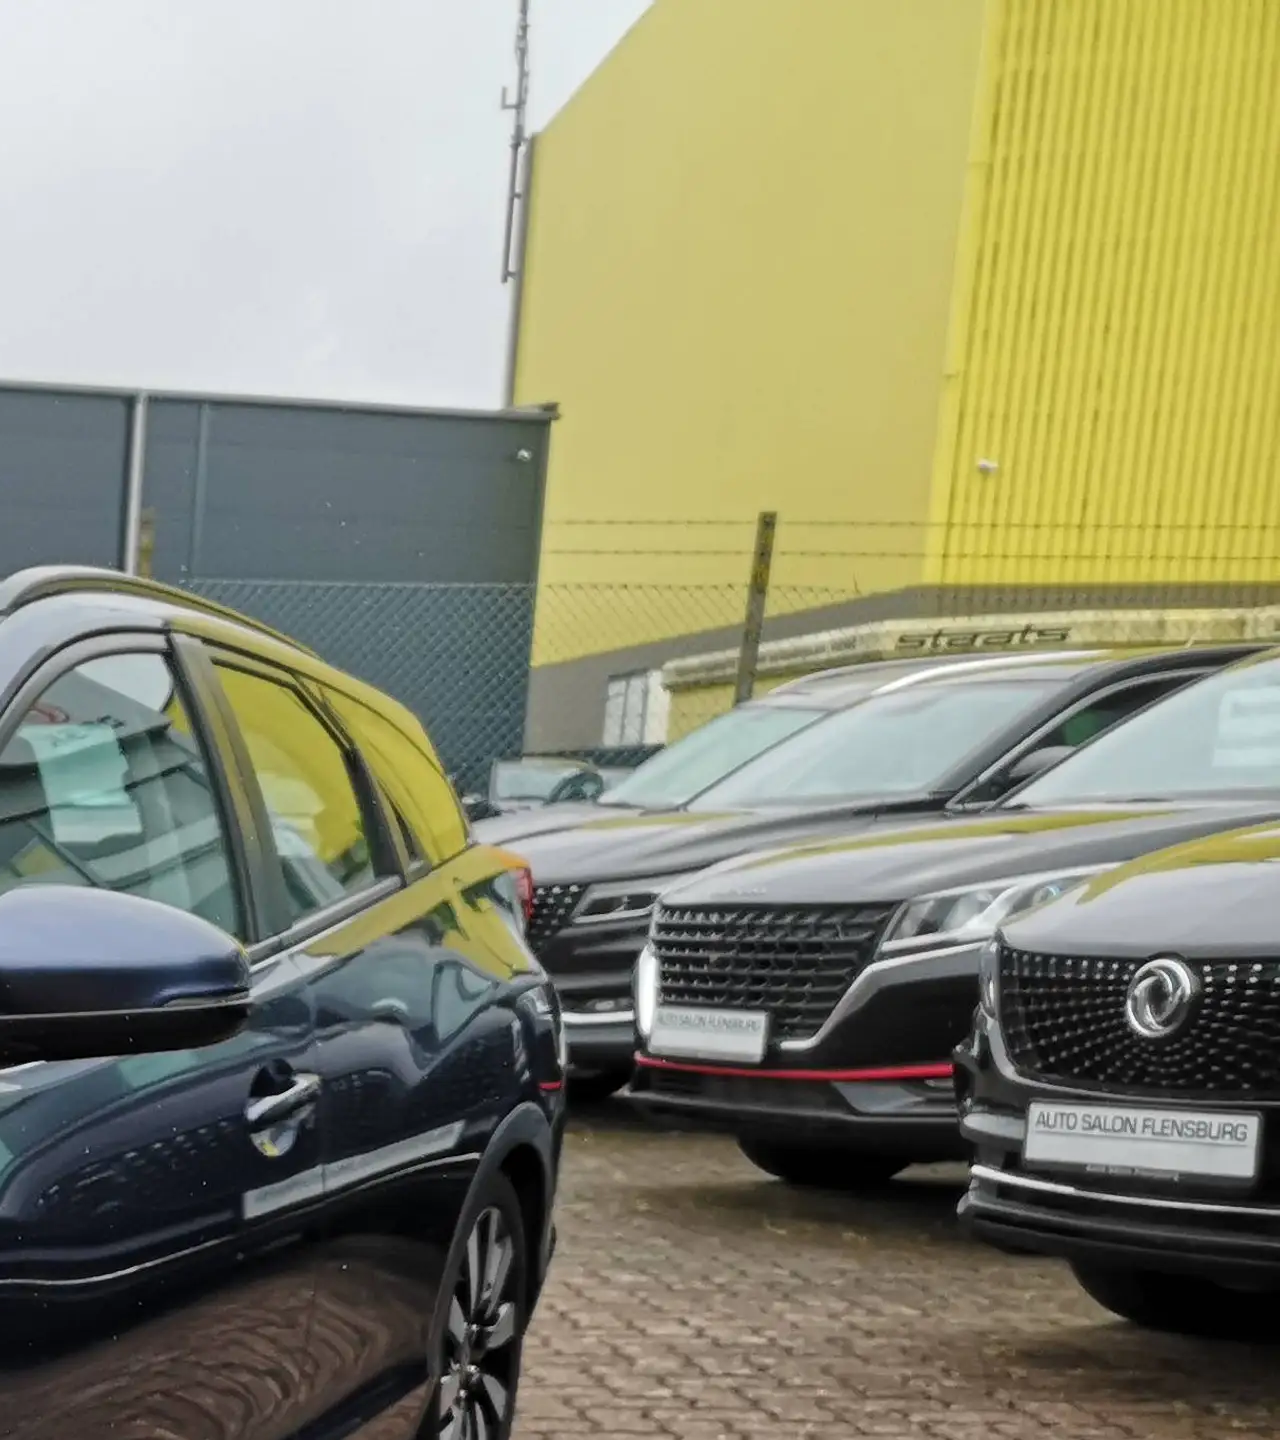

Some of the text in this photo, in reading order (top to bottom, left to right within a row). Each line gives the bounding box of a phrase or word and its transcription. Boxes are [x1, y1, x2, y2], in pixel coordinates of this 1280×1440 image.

[1035, 1111, 1248, 1142] AUTO SALON FLENSBURG
